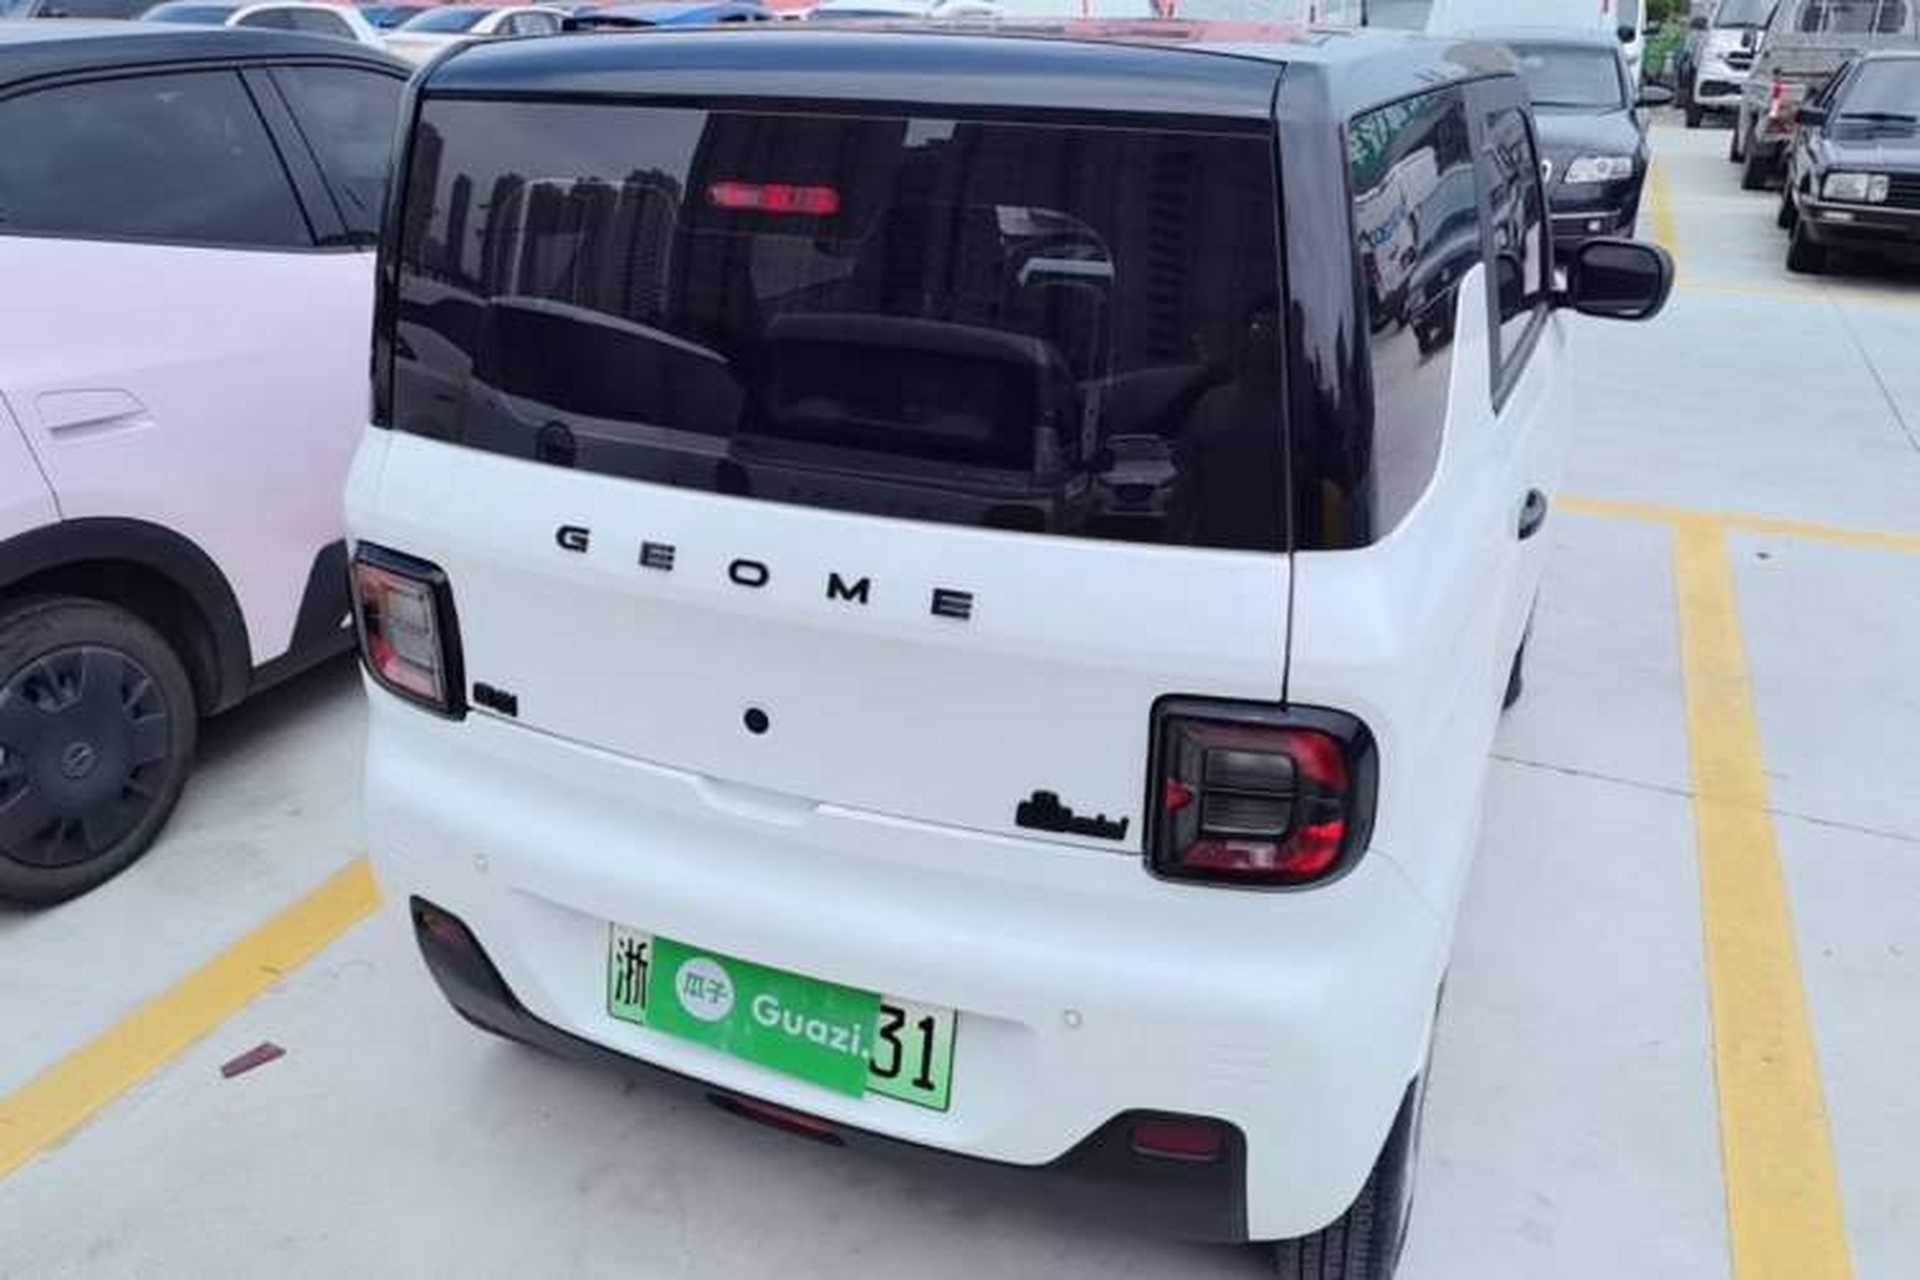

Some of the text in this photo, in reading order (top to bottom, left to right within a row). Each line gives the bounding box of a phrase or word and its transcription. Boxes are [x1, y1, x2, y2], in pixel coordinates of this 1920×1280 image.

[555, 524, 975, 621] GEOME
[614, 938, 648, 1010] 浙
[868, 1003, 937, 1092] 31
